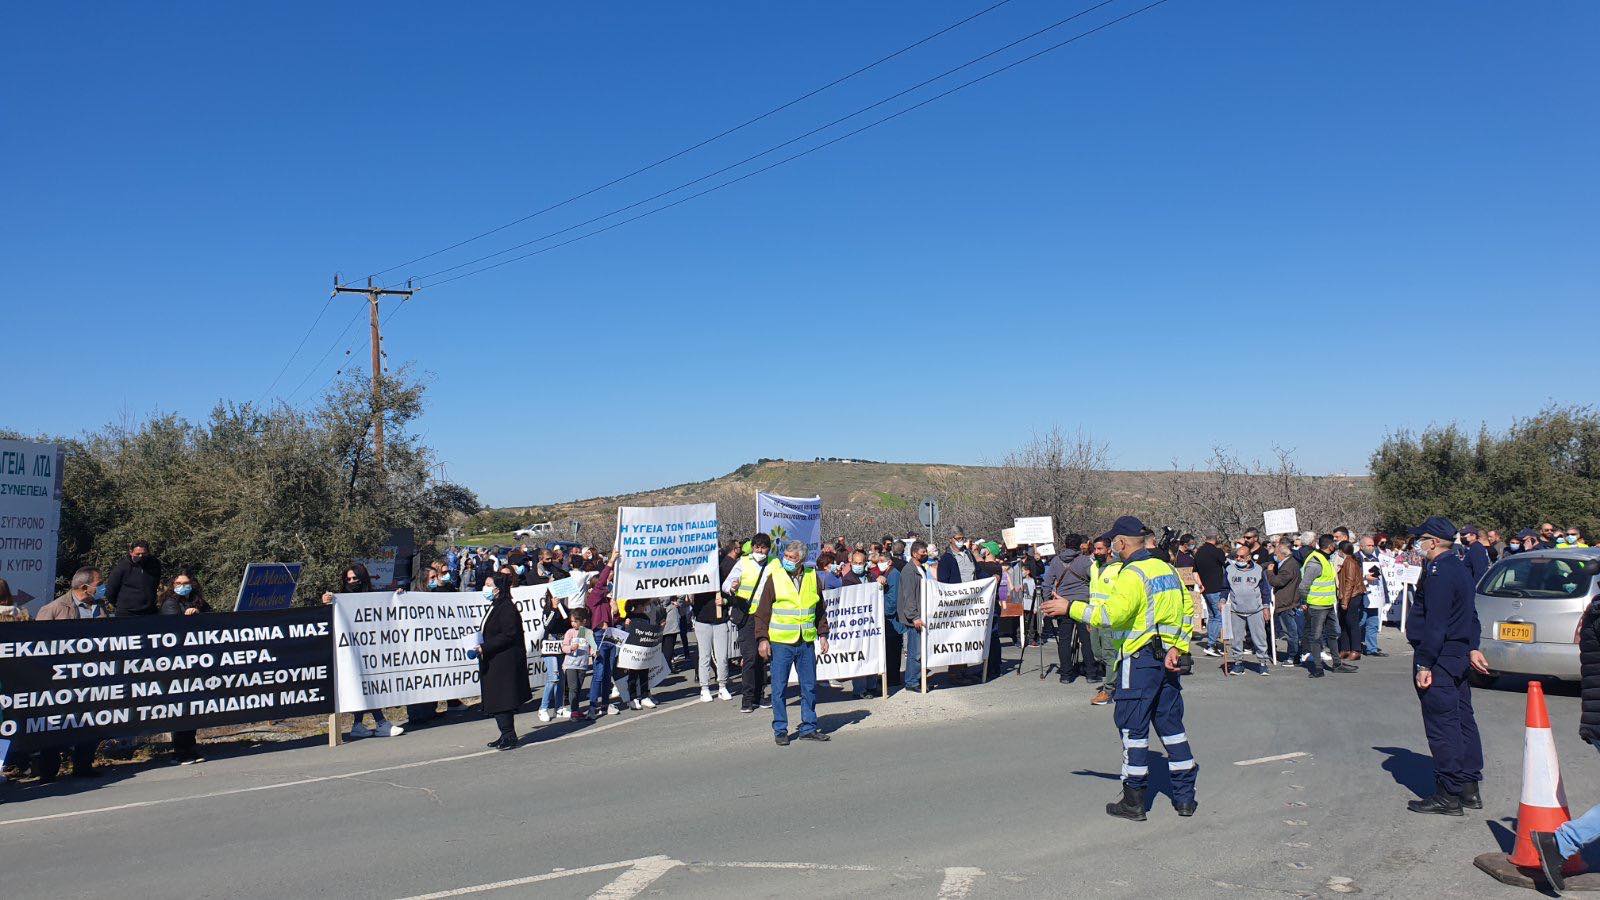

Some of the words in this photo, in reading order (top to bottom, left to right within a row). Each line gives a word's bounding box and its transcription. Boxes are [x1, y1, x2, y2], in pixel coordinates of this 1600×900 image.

[33, 455, 51, 477] ΛΤΔ
[1, 484, 48, 497] ΣΥΝΕΠΕΙΑ
[1, 516, 45, 530] ΣΥΓΧΡΟΝΟ
[621, 524, 628, 533] Η
[633, 524, 663, 533] ΥΓΕΙΑ
[666, 522, 683, 532] ΤΩΝ
[685, 519, 719, 530] ΠΑΙΔΙΩΝ
[623, 536, 646, 545] ΜΑΣ
[649, 536, 676, 545] ΕΙΝΑΙ
[625, 549, 648, 557] ΤΩΝ
[651, 543, 717, 557] ΟΙΚΟΝΟΜΙΚΩΝ
[7, 559, 43, 572] ΚΥΠΡΟ
[636, 556, 709, 569] ΣΥΜΦΕΡΟΝΤΩΝ
[635, 574, 710, 590] ΑΓΡΟΚΗΠΙΑ
[938, 596, 985, 608] ΑΝΑΠΝΕΟΥΜΕ
[354, 607, 382, 622] ΔΕΝ
[386, 605, 434, 621] ΜΠΟΡΩ
[438, 605, 455, 618] ΝΑ
[933, 610, 948, 619] ΔΕΝ
[949, 609, 967, 618] ΕΙΝΑΙ
[969, 607, 989, 616] ΠΡΟΣ
[850, 616, 875, 626] ΦΟΡΑ
[339, 630, 376, 648] ΔΙΚΟΣ
[381, 629, 410, 644] ΜΟΥ
[863, 627, 881, 637] ΜΑΣ
[0, 635, 141, 658] ΕΚΔΙΚΟΥΜΕ
[148, 633, 177, 648] ΤΟ
[184, 625, 284, 646] ΔΙΚΑΙΩΜΑ
[289, 622, 329, 638] ΜΑΣ
[933, 643, 962, 655] ΚΑΤΩ
[52, 661, 115, 680] ΣΤΟΝ
[123, 653, 214, 675] ΚΑΘΑΡΟ
[220, 649, 277, 666] ΑΕΡΑ.
[362, 654, 378, 669] ΤΟ
[382, 649, 441, 667] ΜΕΛΛΟΝ
[0, 685, 124, 710] ΦΕΙΛΟΥΜΕ
[131, 681, 162, 698] ΝΑ
[168, 665, 327, 694] ΔΙΑΦΥΛΑΞΟΥΜΕ
[362, 678, 392, 695] ΕΙΝΑΙ
[396, 670, 480, 692] ΠΑΡΑΠΛΗΡΟ
[26, 708, 129, 734] ΜΕΛΛΟΝ
[137, 702, 183, 720] ΤΩΝ
[190, 693, 274, 715] ΠΑΙΔΙΩΝ
[280, 688, 325, 705] ΜΑΣ.
